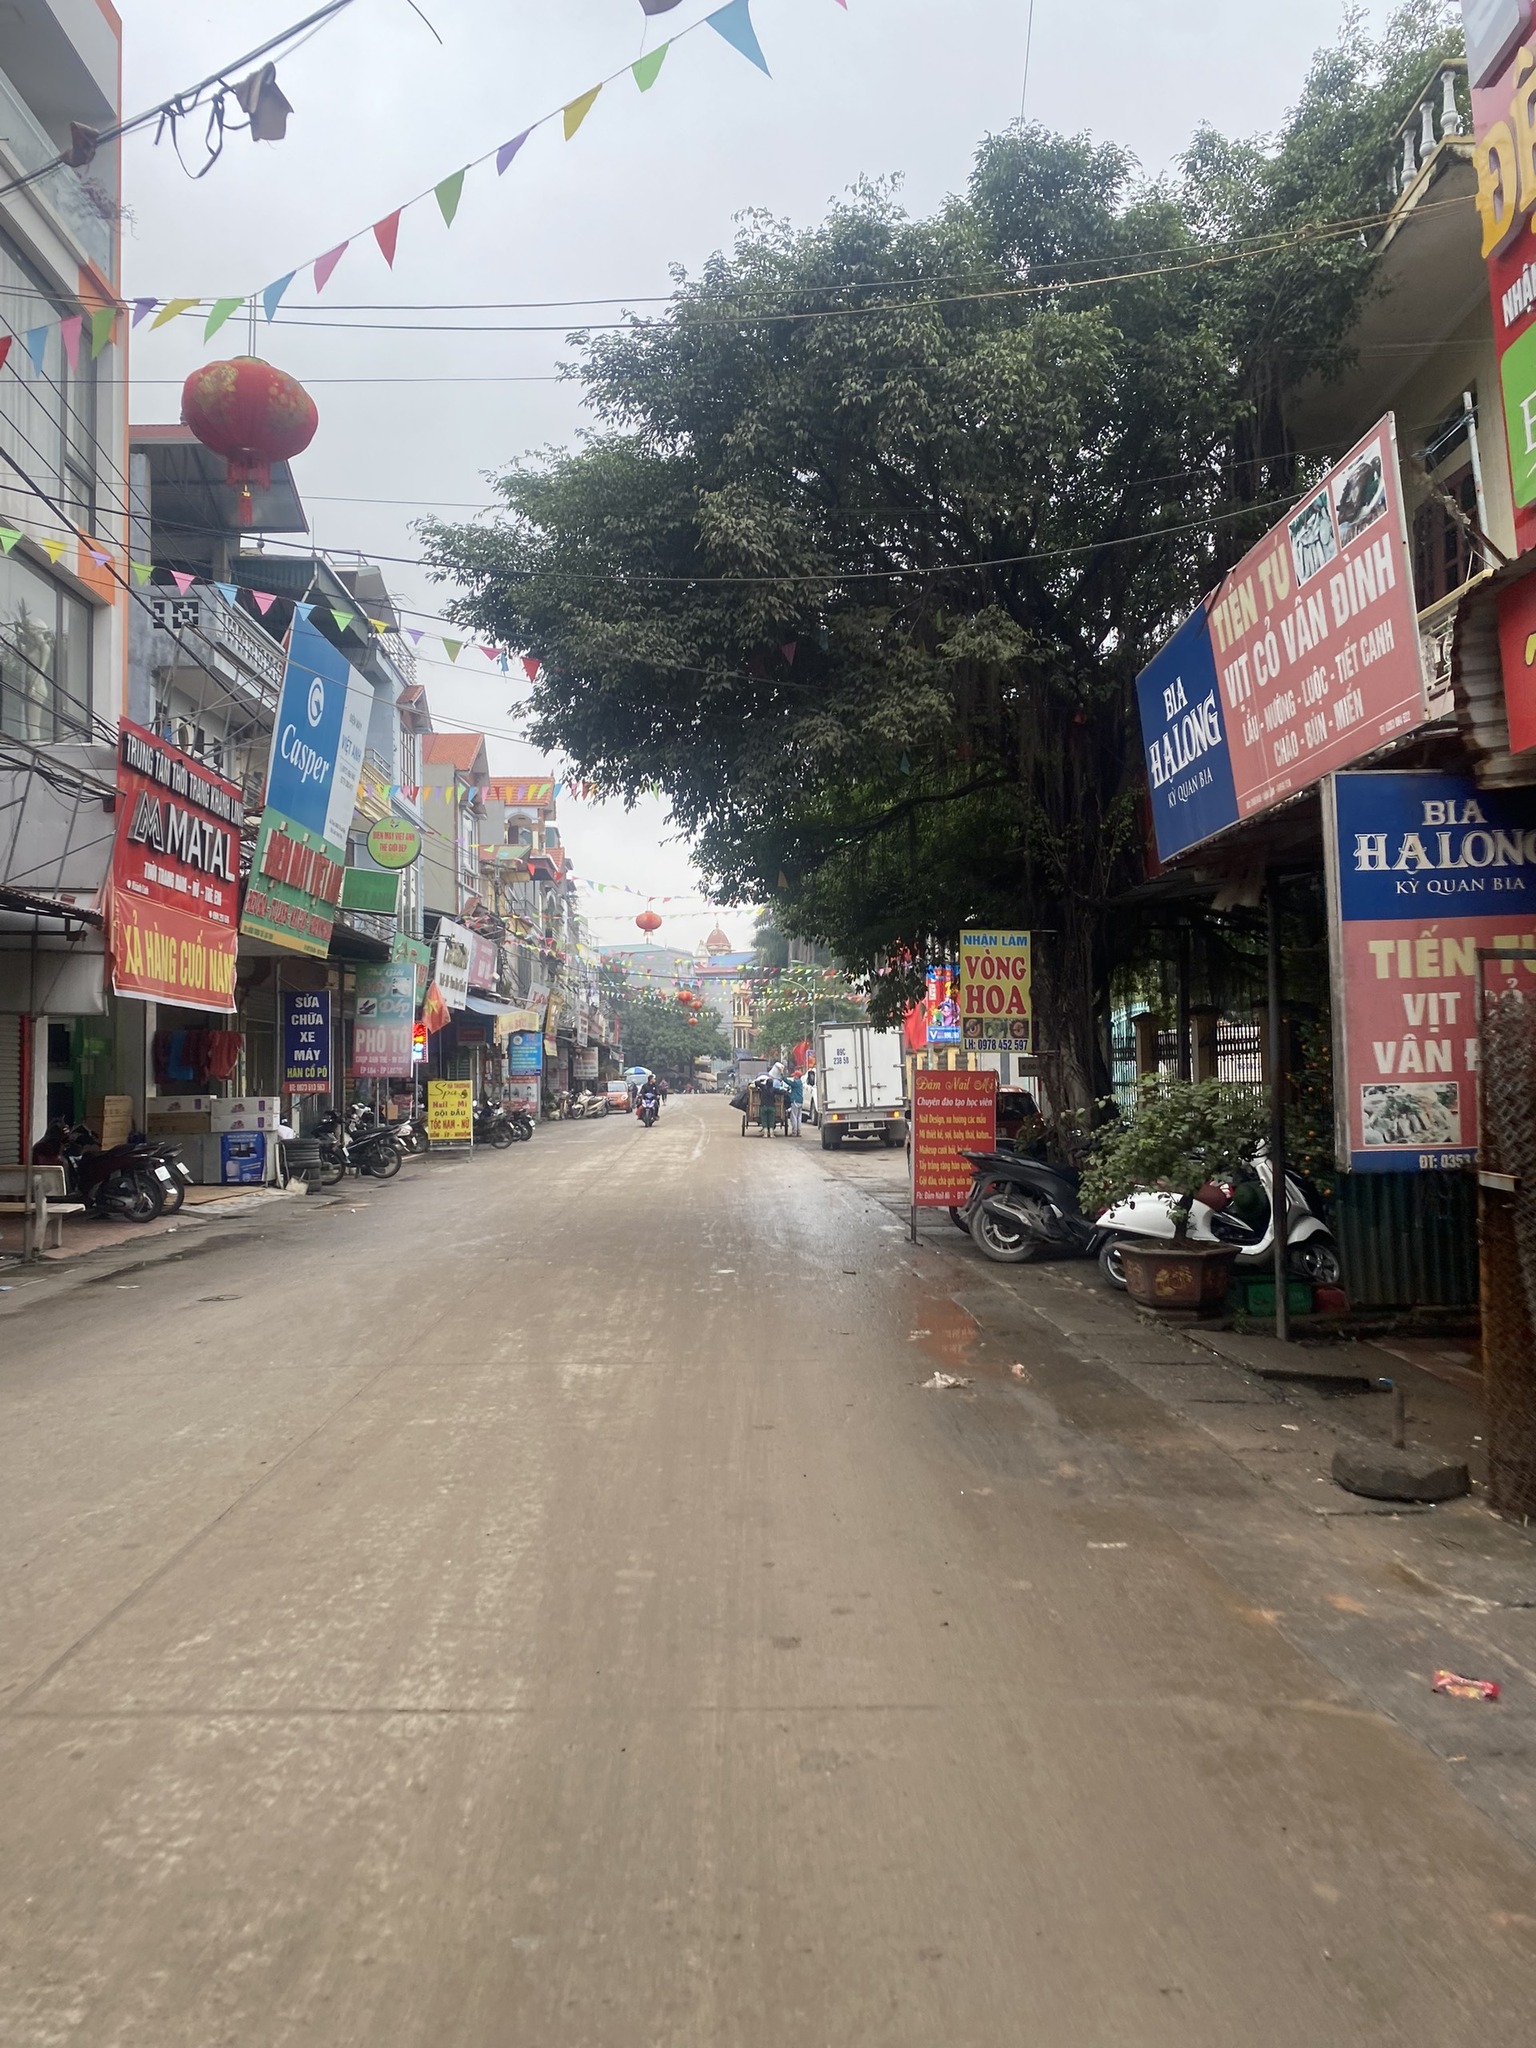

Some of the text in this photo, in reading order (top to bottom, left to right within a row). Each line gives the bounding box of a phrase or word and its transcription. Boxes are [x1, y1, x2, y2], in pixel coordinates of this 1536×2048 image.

[1223, 532, 1396, 712] VỊT CỎ VÂN ĐÌNH
[1301, 665, 1329, 708] LUỘC
[1360, 618, 1395, 668] CANH
[1163, 676, 1188, 721] BIA
[1303, 711, 1328, 749] BÚN
[127, 734, 154, 775] TRUNG
[281, 724, 330, 784] Casper
[1178, 776, 1200, 802] QUAN
[1199, 767, 1213, 788] BIA
[1421, 799, 1488, 826] BIA
[166, 803, 235, 882] MATAL
[1426, 878, 1484, 895] QUAN
[1493, 878, 1526, 891] BIA
[125, 910, 144, 976] XẢ
[145, 922, 177, 984] HÀNG
[180, 930, 206, 990] CUỐI
[963, 933, 1028, 948] NHẬN LÀM
[1368, 925, 1476, 979] TIẾN
[964, 948, 1027, 981] VÒNG
[295, 994, 320, 1008] SỬA
[965, 984, 1027, 1014] HOA
[1402, 992, 1461, 1033] VỊT
[291, 1011, 324, 1025] CHỮA
[300, 1032, 315, 1043] XE
[355, 1025, 384, 1053] PHÔ
[964, 1039, 1028, 1051] LH: 0978 452 597
[294, 1047, 321, 1061] MÁY
[1372, 1033, 1453, 1074] VÂN
[429, 1082, 458, 1099] Spa
[945, 1076, 971, 1091] Nail
[966, 1097, 978, 1108] học
